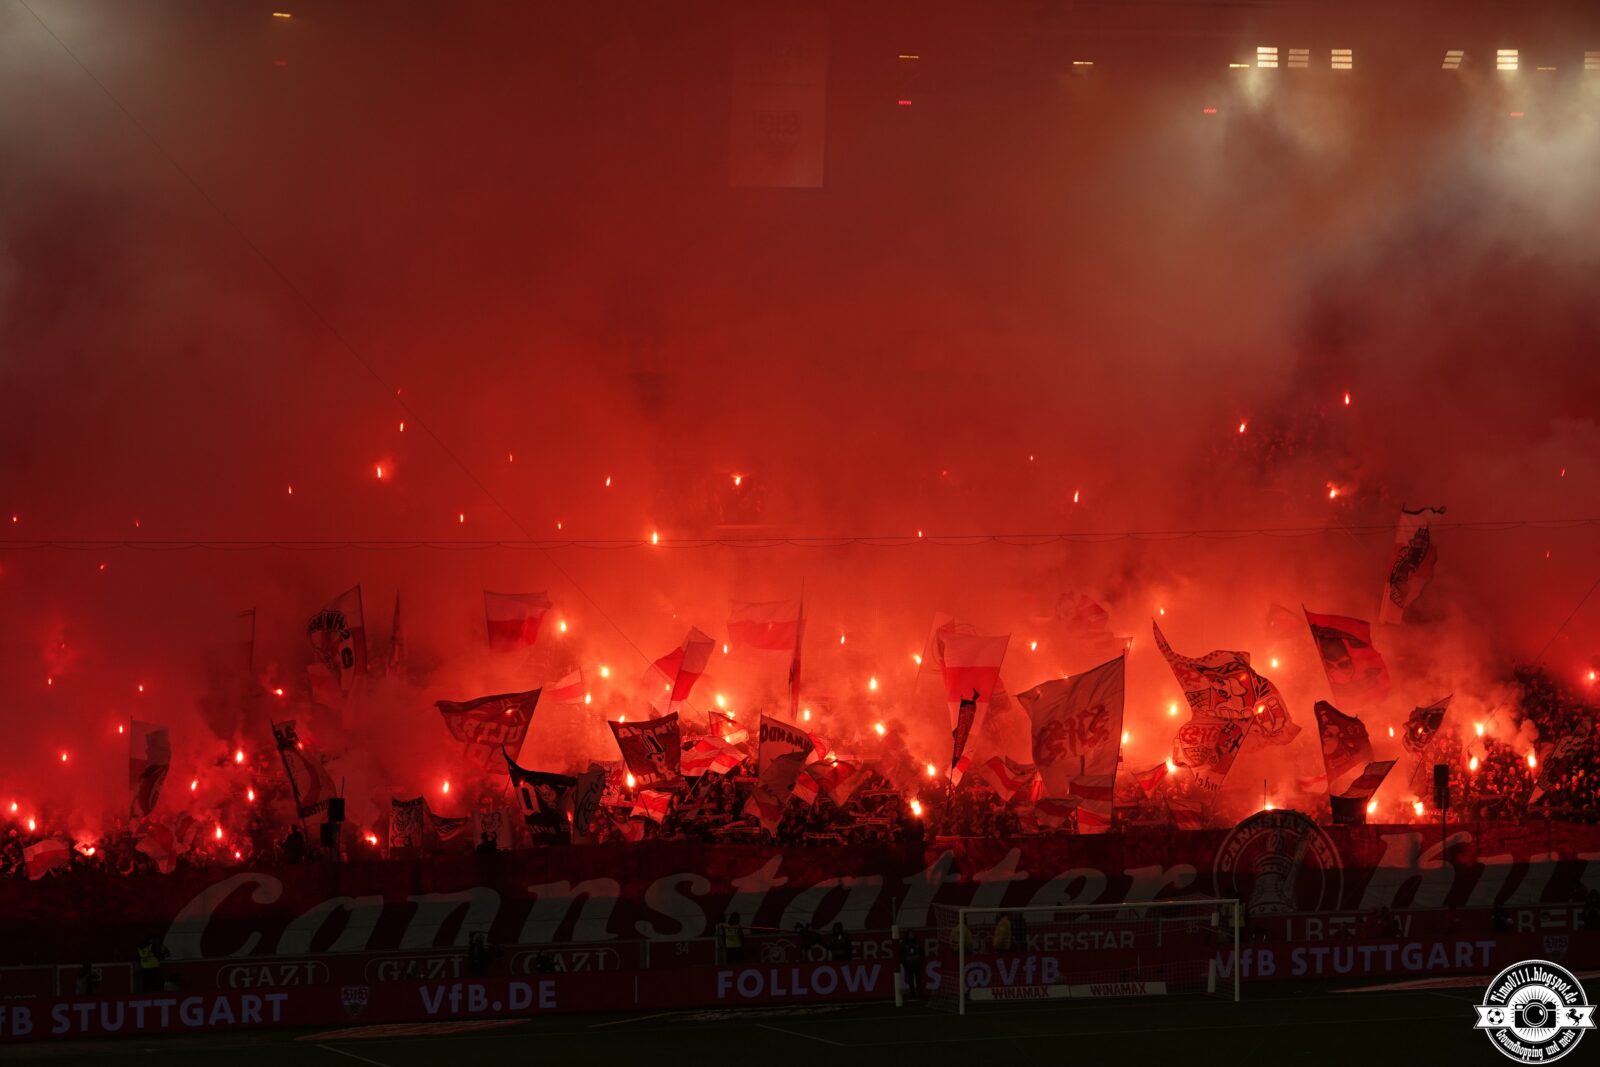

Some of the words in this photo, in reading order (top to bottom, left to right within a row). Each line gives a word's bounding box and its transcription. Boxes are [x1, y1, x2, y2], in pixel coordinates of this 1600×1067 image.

[163, 847, 1198, 960] Cannstatter
[1358, 831, 1600, 911] Ku
[717, 963, 882, 999] FOLLOW
[965, 955, 1060, 990] @VfB
[1215, 947, 1277, 978] VfB
[1291, 940, 1497, 977] STUTTGART
[419, 980, 558, 1015] VfB.DE
[991, 985, 1049, 999] WINAMAX
[1090, 982, 1147, 997] WINAMAX
[50, 992, 289, 1035] STUTTGART
